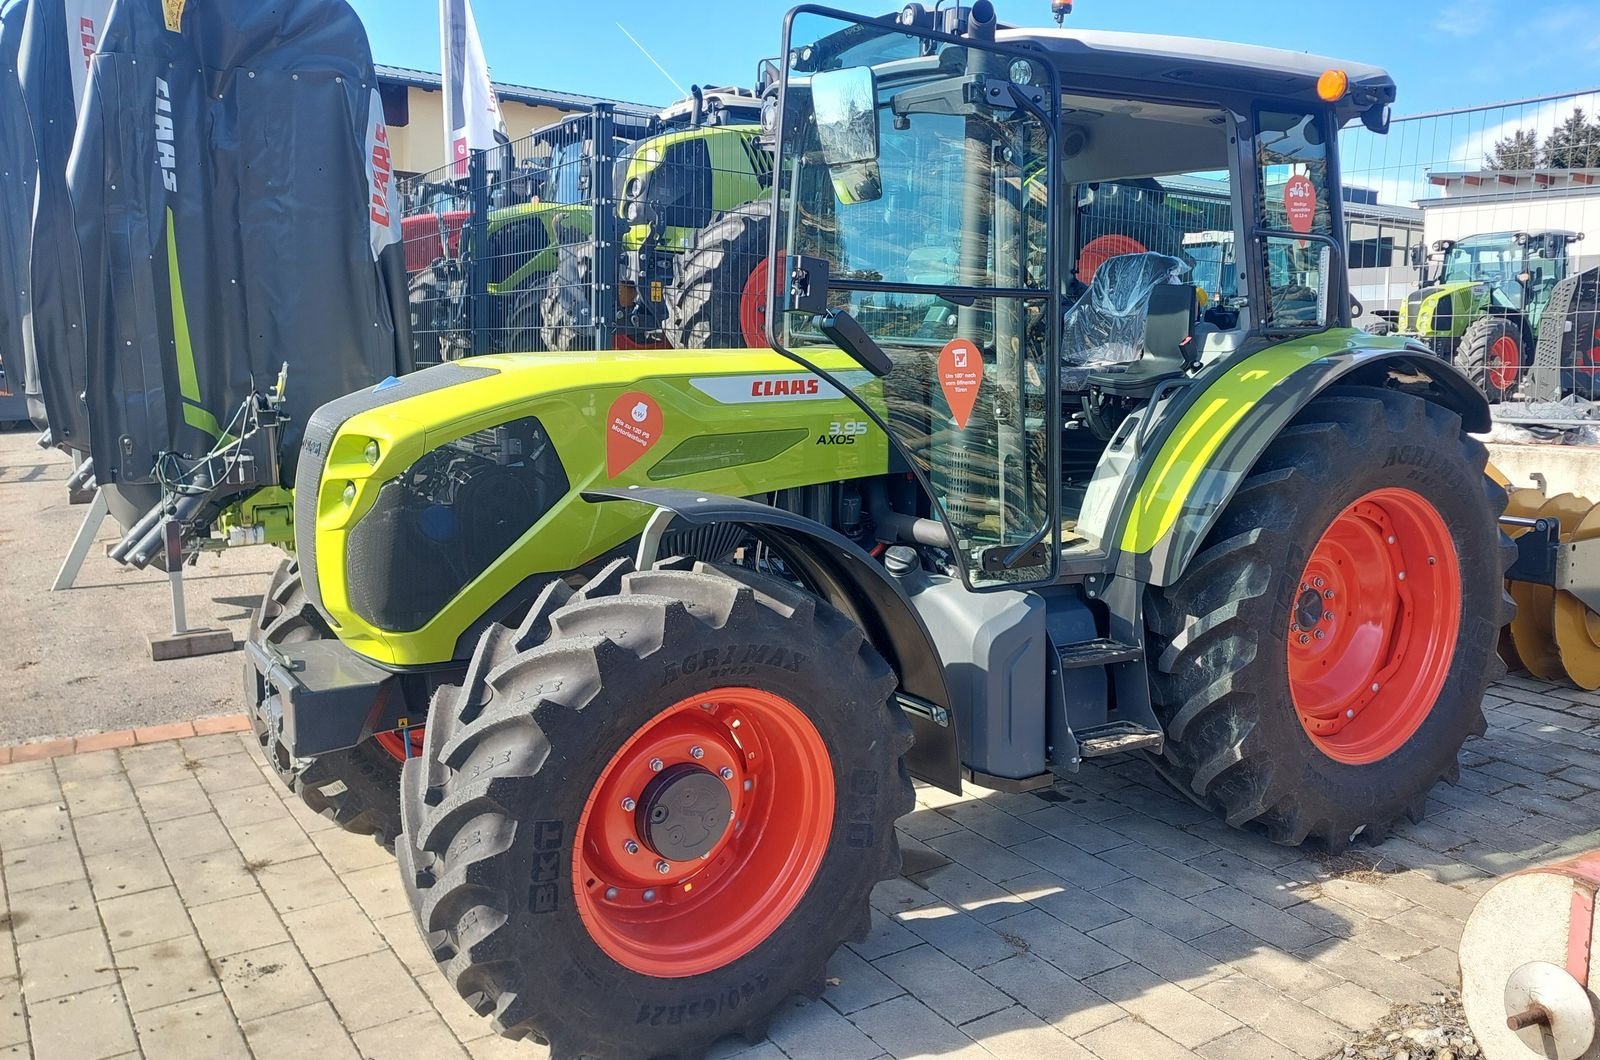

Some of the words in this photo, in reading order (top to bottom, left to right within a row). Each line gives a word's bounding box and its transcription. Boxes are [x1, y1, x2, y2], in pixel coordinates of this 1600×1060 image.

[80, 17, 96, 73] CLA
[155, 76, 178, 193] CLAAS
[371, 122, 391, 227] CLAAS
[751, 379, 818, 397] CLAAS
[611, 424, 648, 447] Motorleistung
[615, 418, 624, 426] Bis
[632, 426, 642, 435] 120
[641, 431, 650, 439] PS
[816, 434, 856, 445] AXOS
[828, 421, 868, 435] 3.95
[528, 820, 563, 914] BKT
